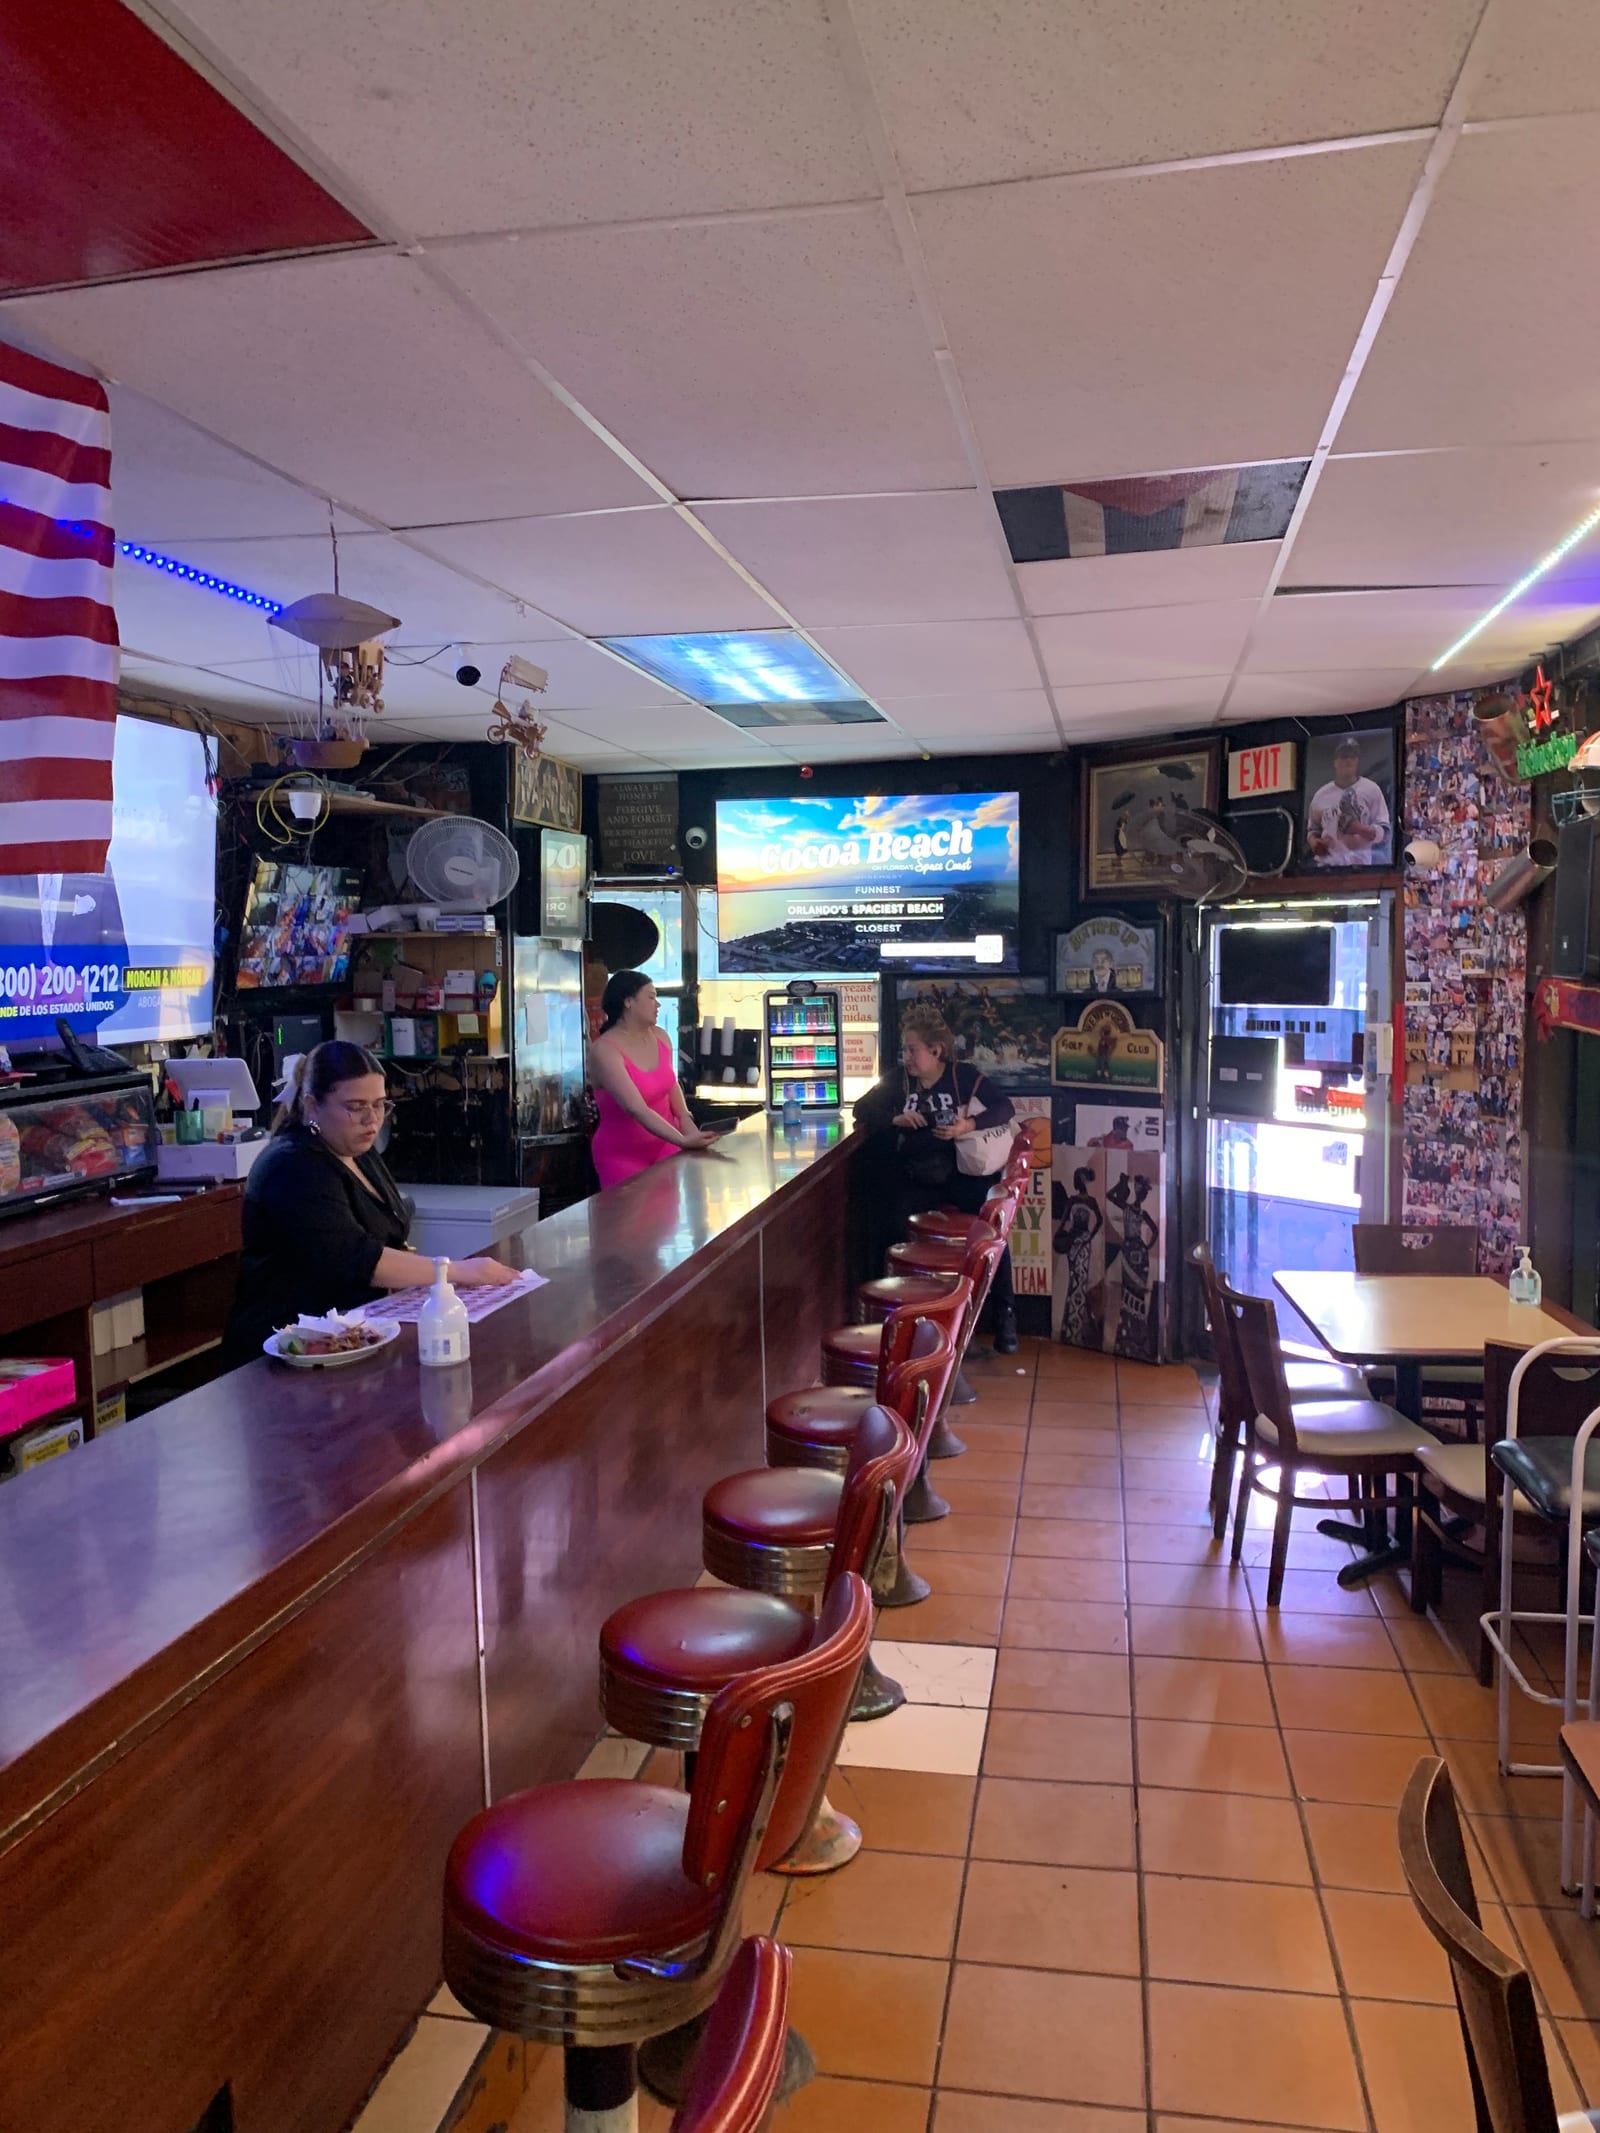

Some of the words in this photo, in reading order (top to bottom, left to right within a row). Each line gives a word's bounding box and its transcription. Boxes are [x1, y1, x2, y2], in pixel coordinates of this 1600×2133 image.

[1239, 747, 1281, 792] EXIT
[619, 792, 657, 801] HONEST
[616, 805, 662, 814] FORGIVE
[607, 816, 628, 825] AND
[631, 814, 672, 824] FORGET
[759, 840, 860, 874] Cocoa
[866, 820, 973, 864] Beach
[623, 850, 657, 862] LOVE
[914, 859, 943, 875] Space
[945, 857, 972, 871] Coast
[855, 885, 901, 895] FUNNEST
[788, 904, 848, 915] ORLANDO'S
[851, 903, 905, 915] SPACIEST
[907, 903, 944, 913] BEACH
[855, 924, 902, 933] CLOSEST
[41, 964, 119, 995] 200-1212
[126, 969, 161, 988] MORGAN
[162, 969, 169, 987] &
[170, 968, 204, 986] MORGAN
[843, 994, 877, 1003] mente
[0, 1006, 19, 1018] NDE
[19, 1006, 31, 1017] DE
[32, 1004, 48, 1016] LOS
[50, 1002, 85, 1014] ESTADOS
[86, 1000, 114, 1012] UNIDOS
[1061, 1039, 1083, 1050] GOLF
[1127, 1043, 1150, 1054] CLUB
[1012, 1207, 1046, 1230] AY
[1013, 1267, 1047, 1293] TEAM
